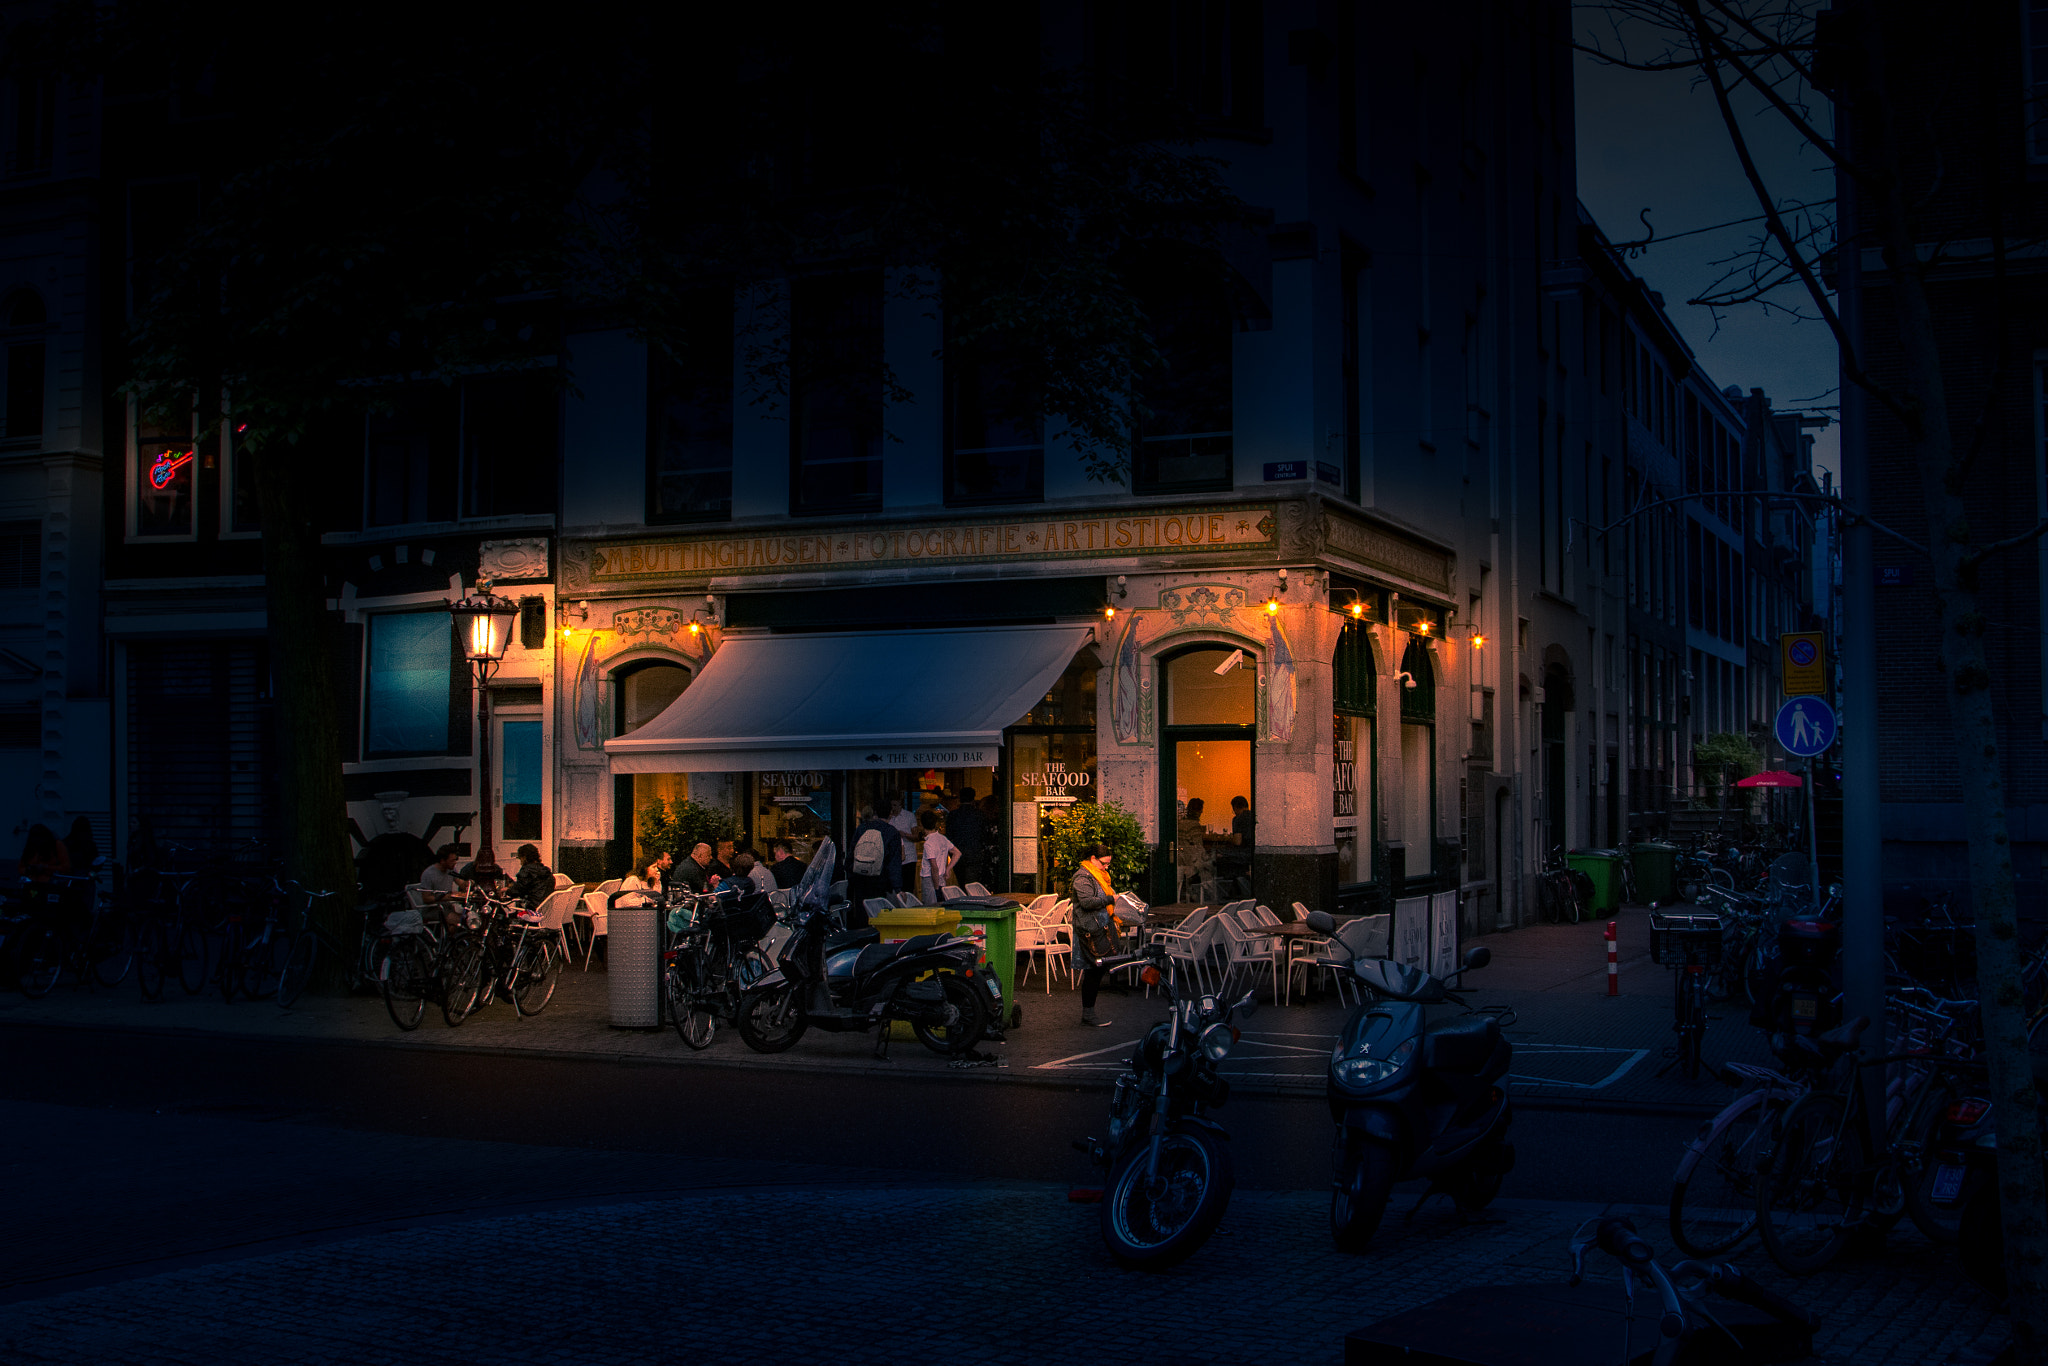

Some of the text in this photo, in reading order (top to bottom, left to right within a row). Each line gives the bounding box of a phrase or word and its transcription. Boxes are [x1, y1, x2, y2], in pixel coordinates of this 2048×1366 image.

[1277, 463, 1293, 472] SPUI
[854, 526, 1021, 561] FOTOGRAFIE
[1044, 515, 1225, 551] ARTISTIQUE
[1338, 740, 1354, 761] THE
[887, 752, 984, 763] THE SEAFOOD BAR
[1044, 763, 1066, 773] THE
[762, 773, 824, 787] SEAFOOD
[1021, 772, 1090, 787] SEAFOOD
[784, 787, 802, 796] BAR
[1045, 787, 1066, 796] BAR
[1339, 793, 1353, 814] BAR
